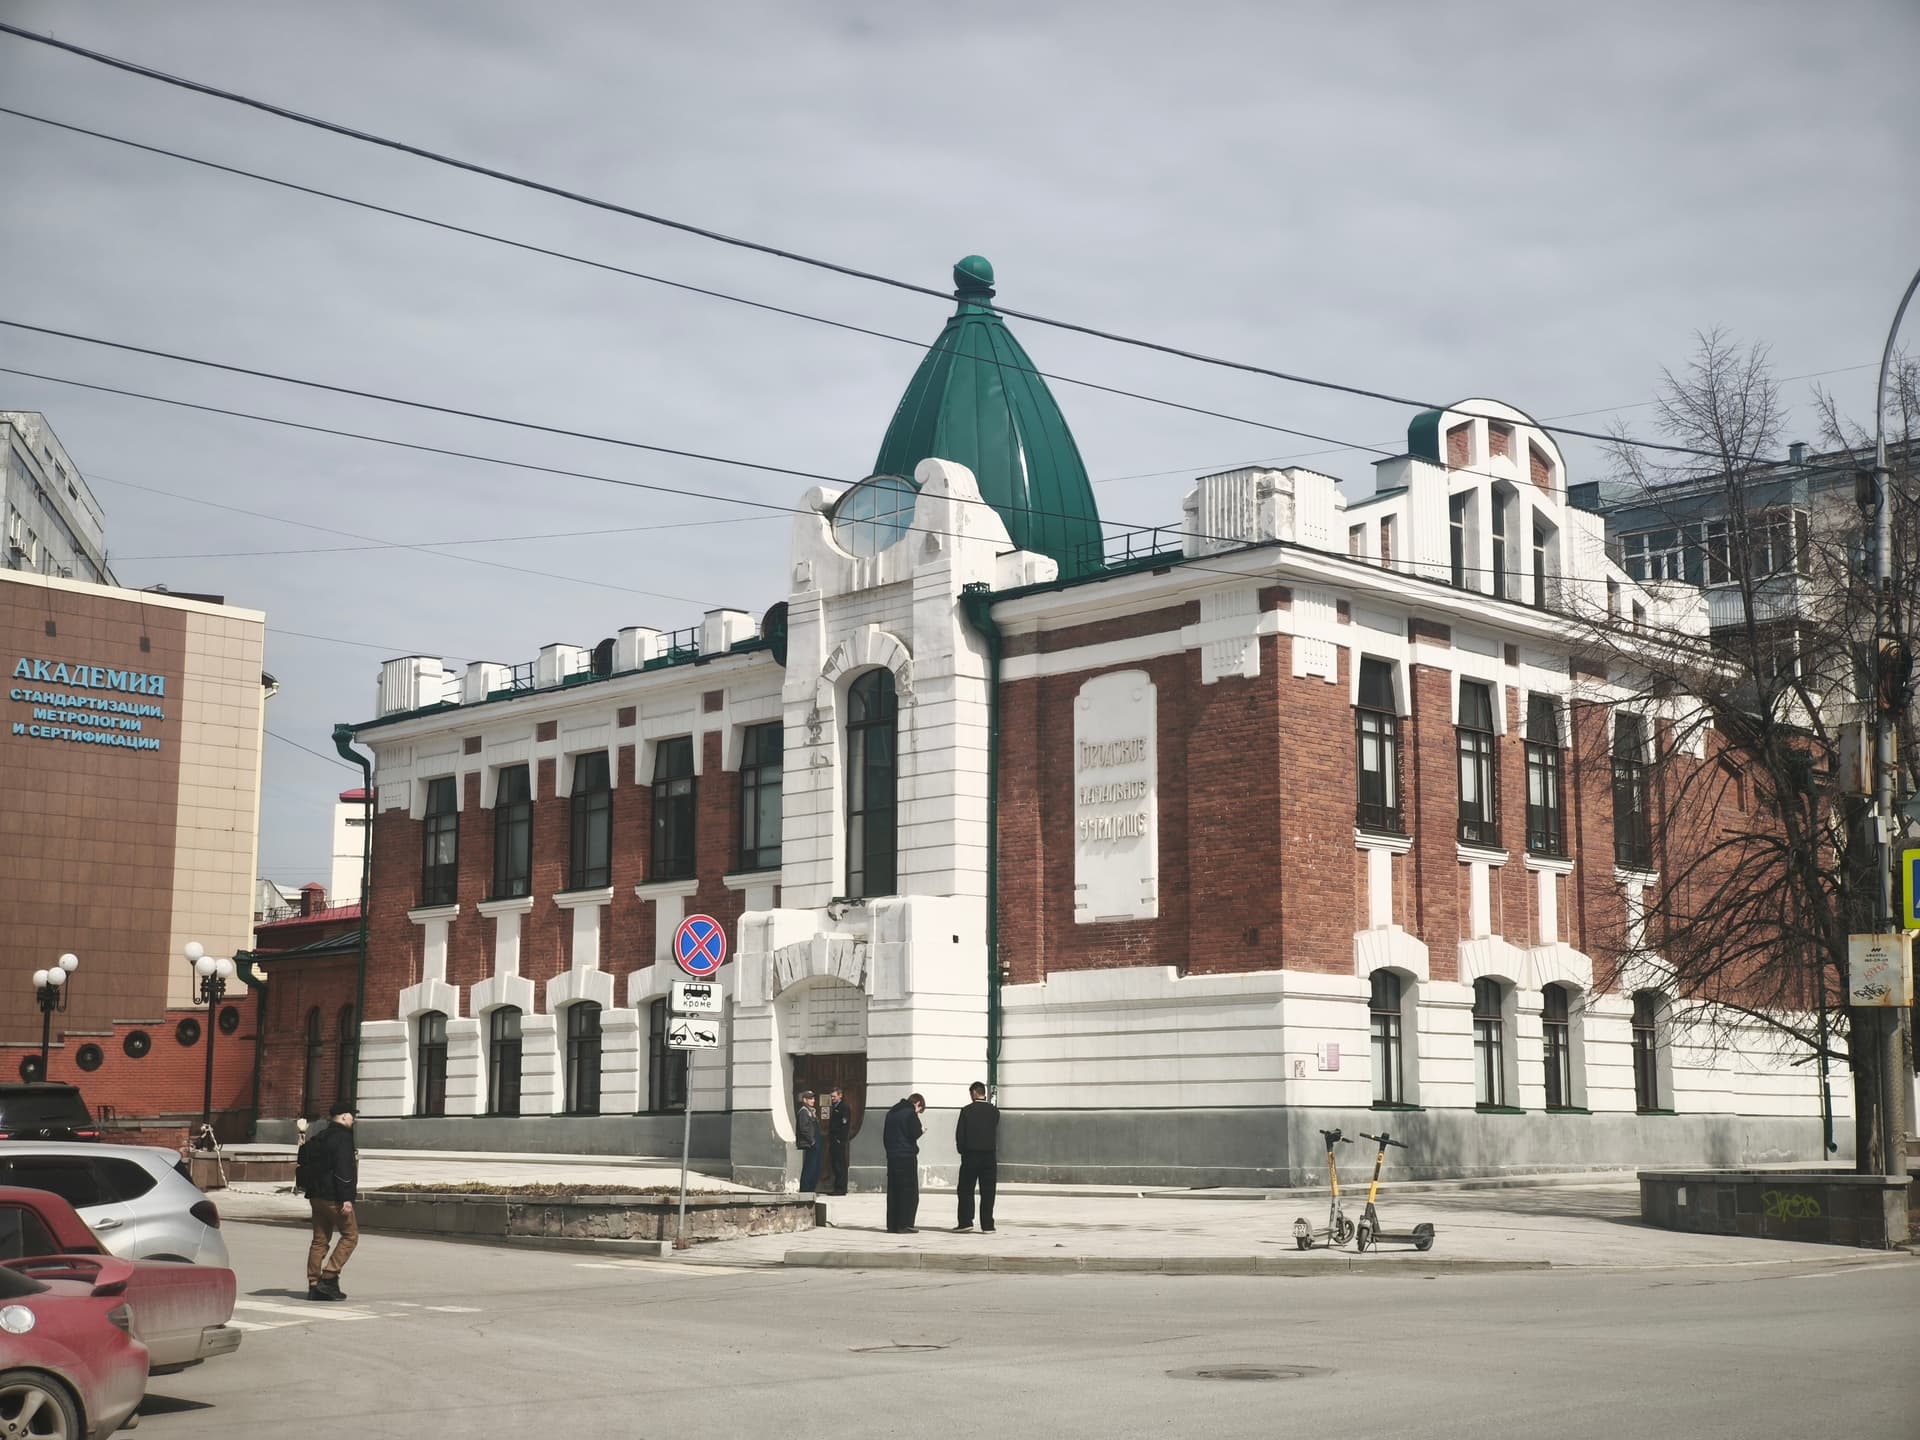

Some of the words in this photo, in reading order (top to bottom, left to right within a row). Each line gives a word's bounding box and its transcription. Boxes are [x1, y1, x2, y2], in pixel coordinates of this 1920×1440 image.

[13, 657, 165, 697] АКАДЕМИЯ
[10, 688, 165, 720] СТАНДАРТИЗАЦИИ,
[33, 708, 142, 732] МЕТРОЛОГИИ
[12, 722, 25, 736] И
[29, 725, 160, 751] СЕРТИФИКАЦИИ
